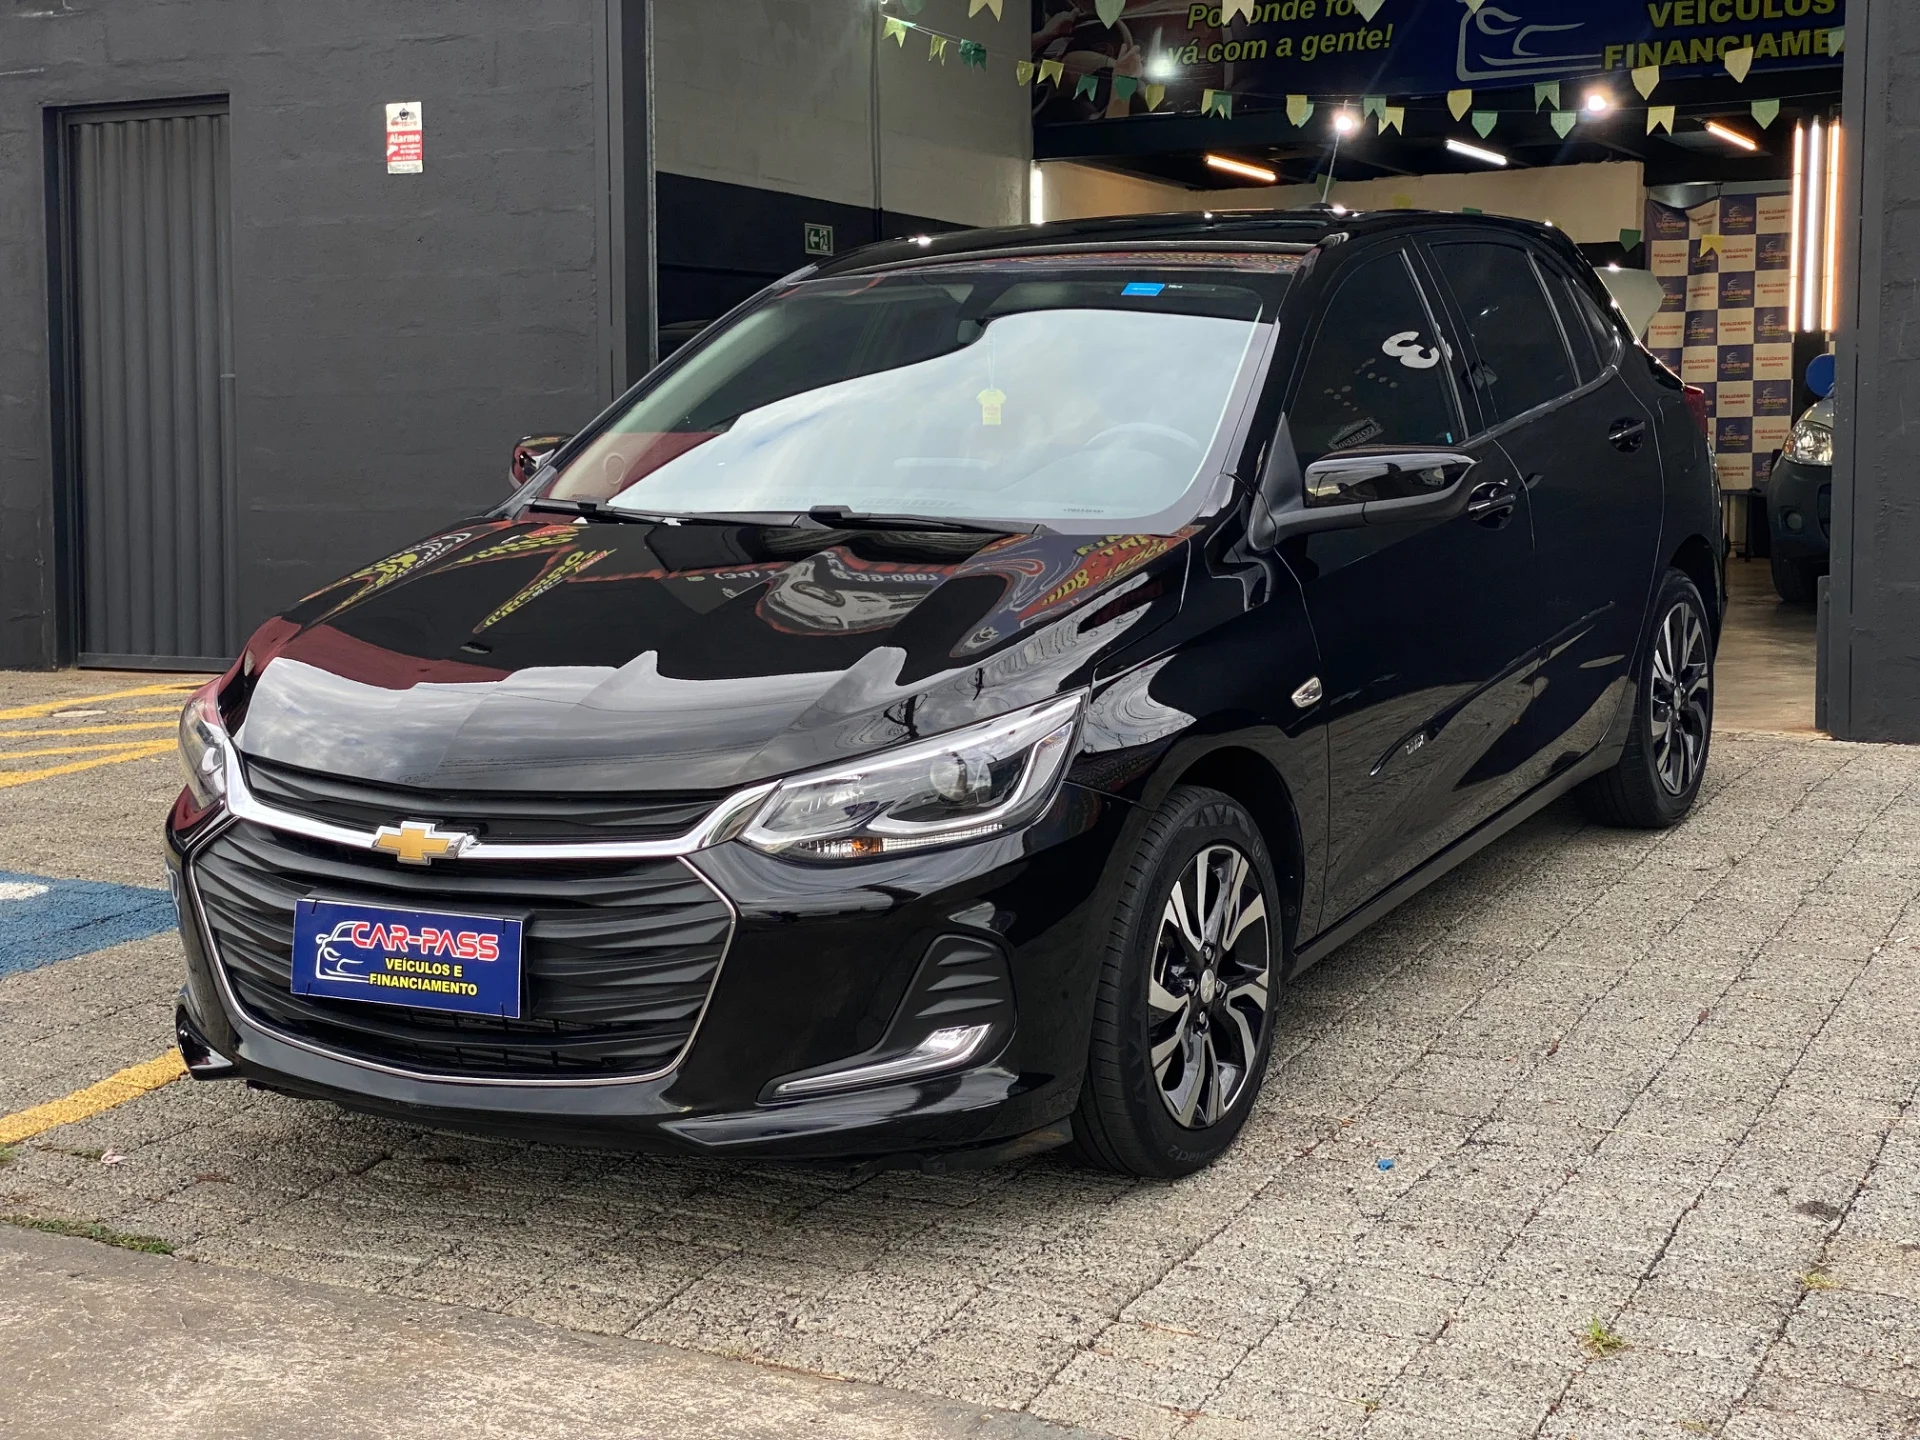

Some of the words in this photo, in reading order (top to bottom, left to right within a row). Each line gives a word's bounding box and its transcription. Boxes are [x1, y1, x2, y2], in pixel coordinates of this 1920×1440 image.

[1186, 4, 1232, 30] Po
[1325, 0, 1359, 18] fo
[1167, 38, 1200, 66] vá
[1206, 39, 1268, 64] com
[1275, 36, 1293, 58] a
[1300, 23, 1395, 62] gente!
[1603, 28, 1845, 71] FINANCIAME
[389, 132, 421, 144] Alarme
[351, 920, 500, 962] CAR-PASS
[384, 957, 451, 977] VEÍCULOS
[453, 965, 463, 978] E
[368, 972, 479, 997] FINANCIAMENTO
